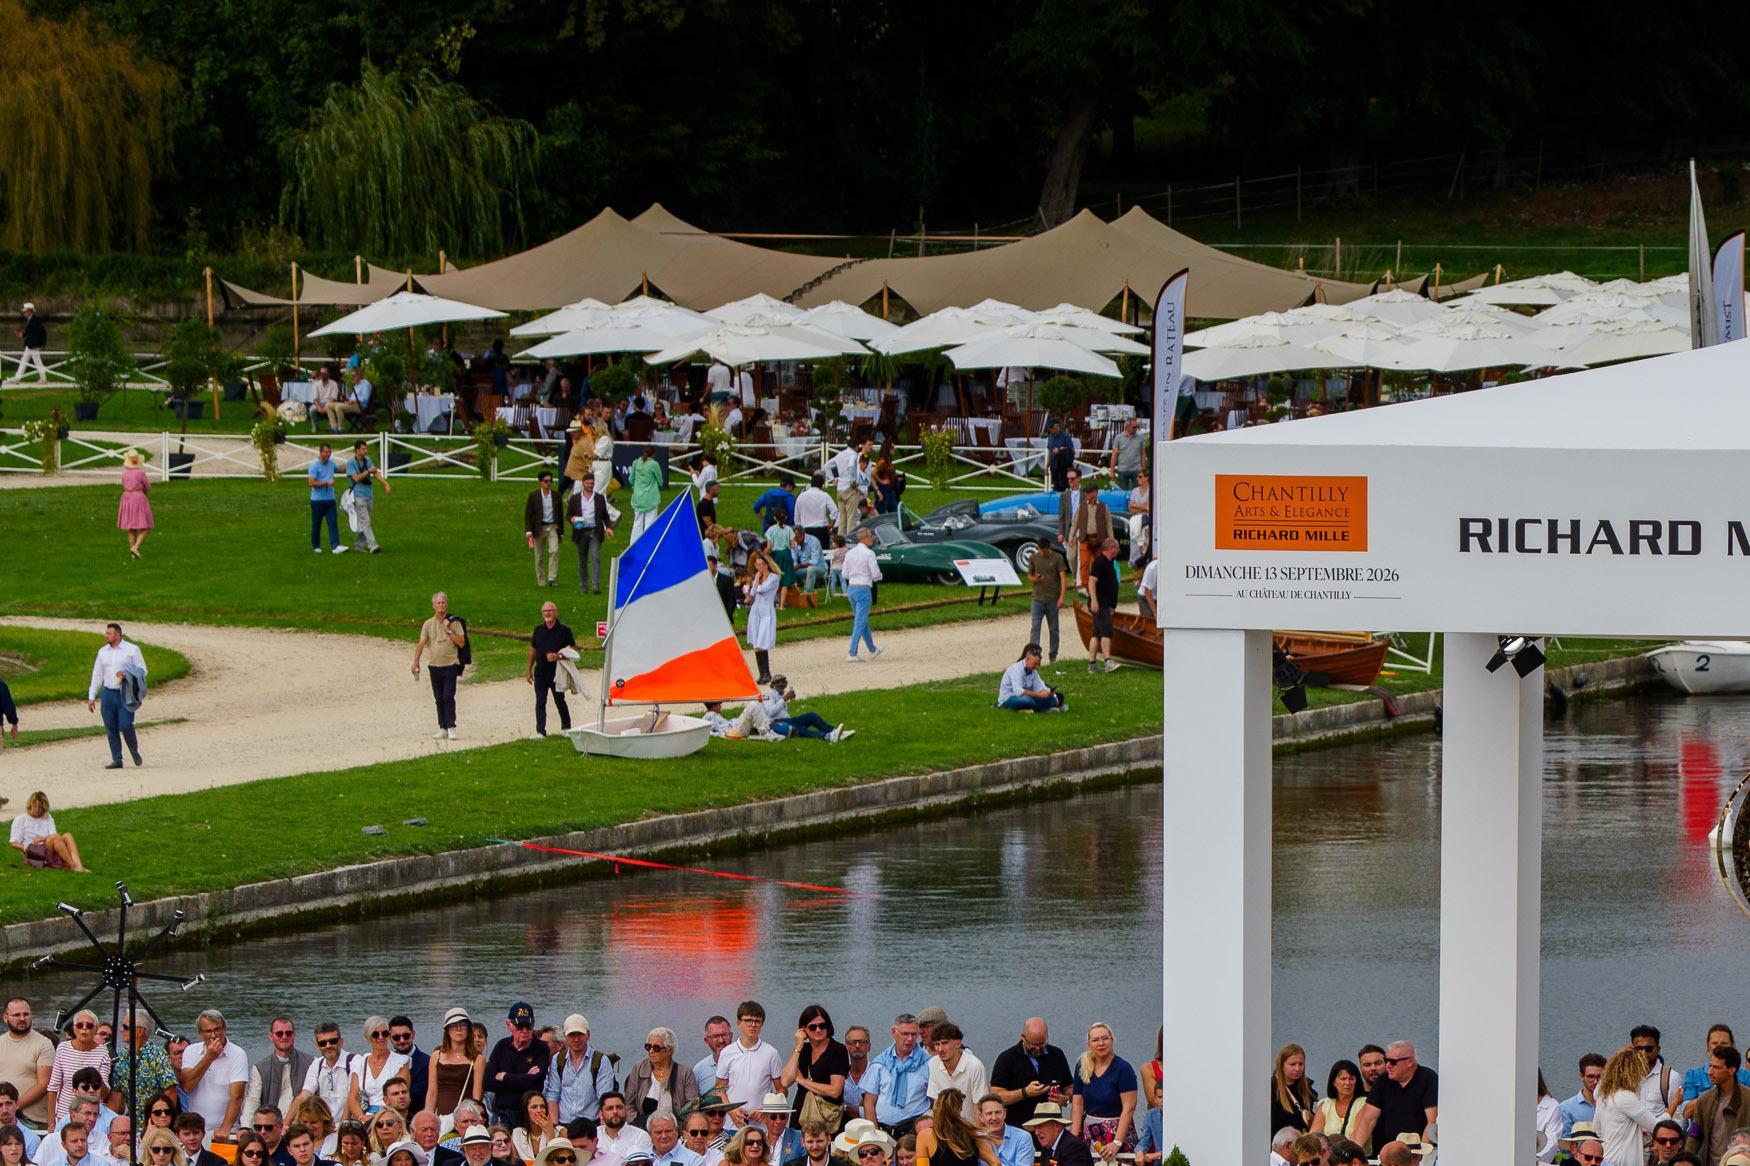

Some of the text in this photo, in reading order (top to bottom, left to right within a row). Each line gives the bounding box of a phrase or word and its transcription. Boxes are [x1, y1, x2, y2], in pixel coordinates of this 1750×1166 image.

[1165, 302, 1176, 366] RATEAU
[1233, 481, 1350, 502] CHANTILLY
[1234, 504, 1350, 519] ARTS & ELEGANCE
[1233, 529, 1350, 542] RICHARD MILLE
[1458, 516, 1702, 556] RICHARD
[1185, 565, 1400, 582] DIMANCHE 13 SEPTEMBRE 2026
[1236, 588, 1352, 600] AU CHÂTEAU DE CHANTILLY
[1695, 654, 1710, 672] 2
